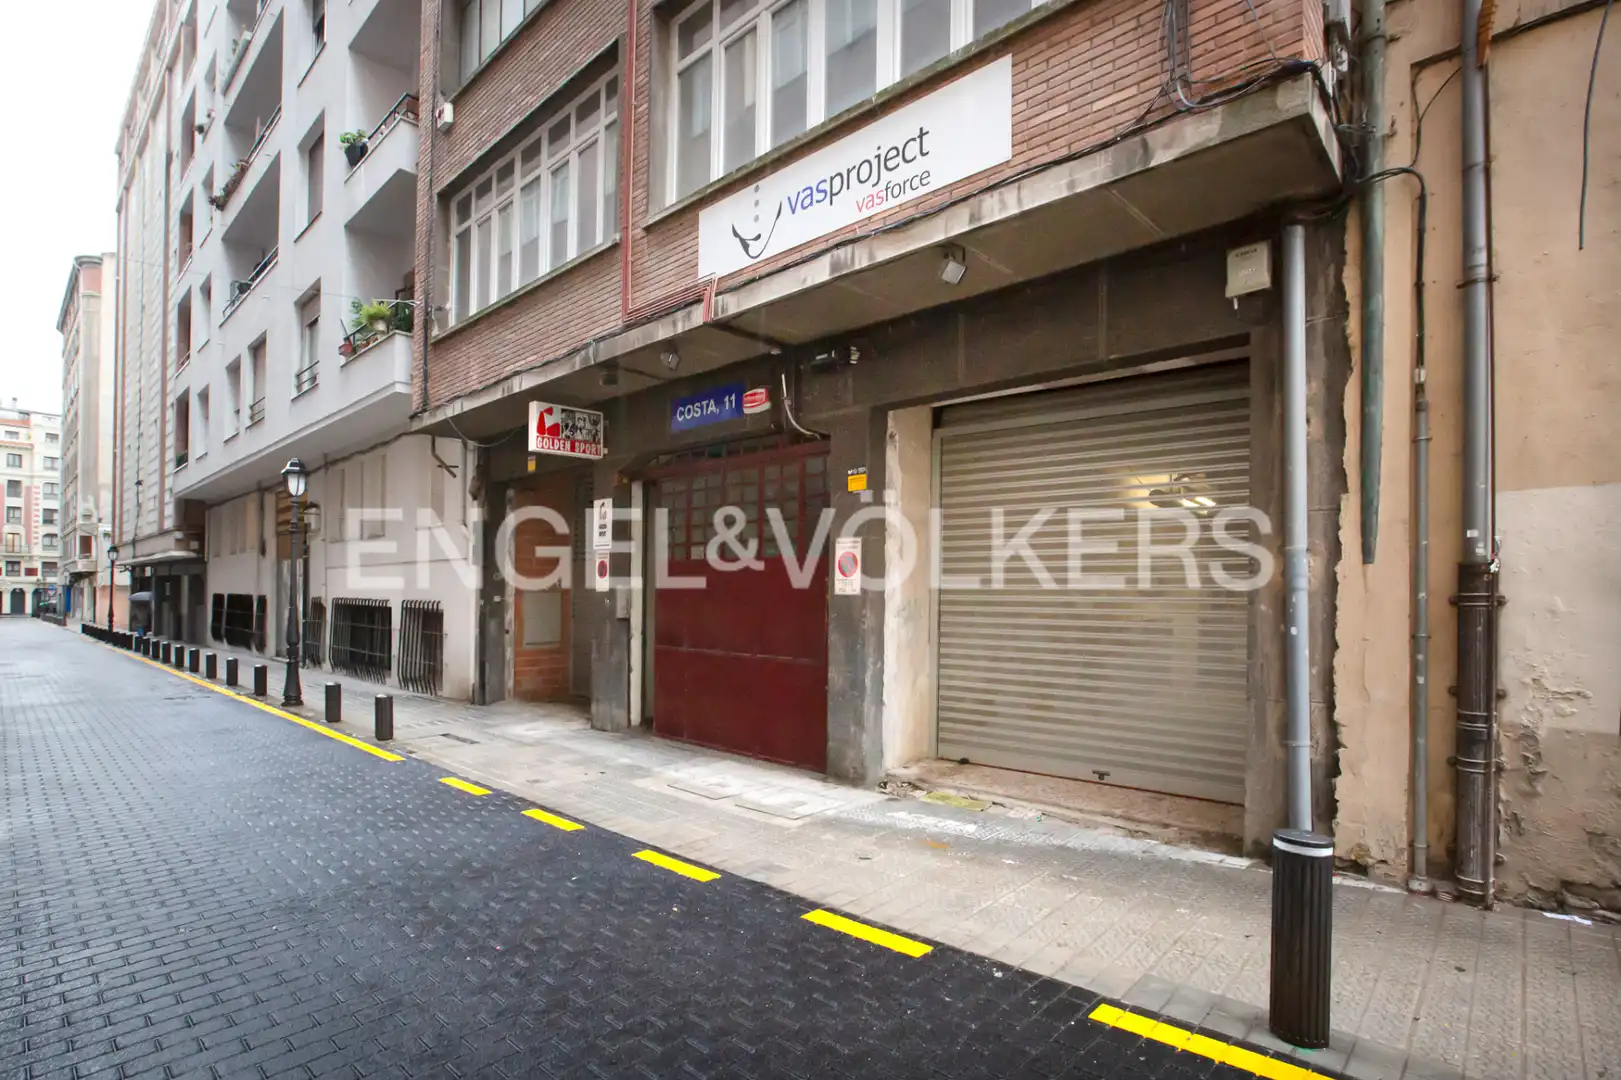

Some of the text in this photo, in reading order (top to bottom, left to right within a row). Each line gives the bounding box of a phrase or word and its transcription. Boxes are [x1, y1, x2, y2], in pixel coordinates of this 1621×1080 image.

[787, 126, 930, 215] vasproject
[855, 168, 931, 213] vasforce
[676, 398, 720, 422] COSTA,
[723, 391, 736, 410] 11
[537, 437, 601, 456] GOLDEN SPORT
